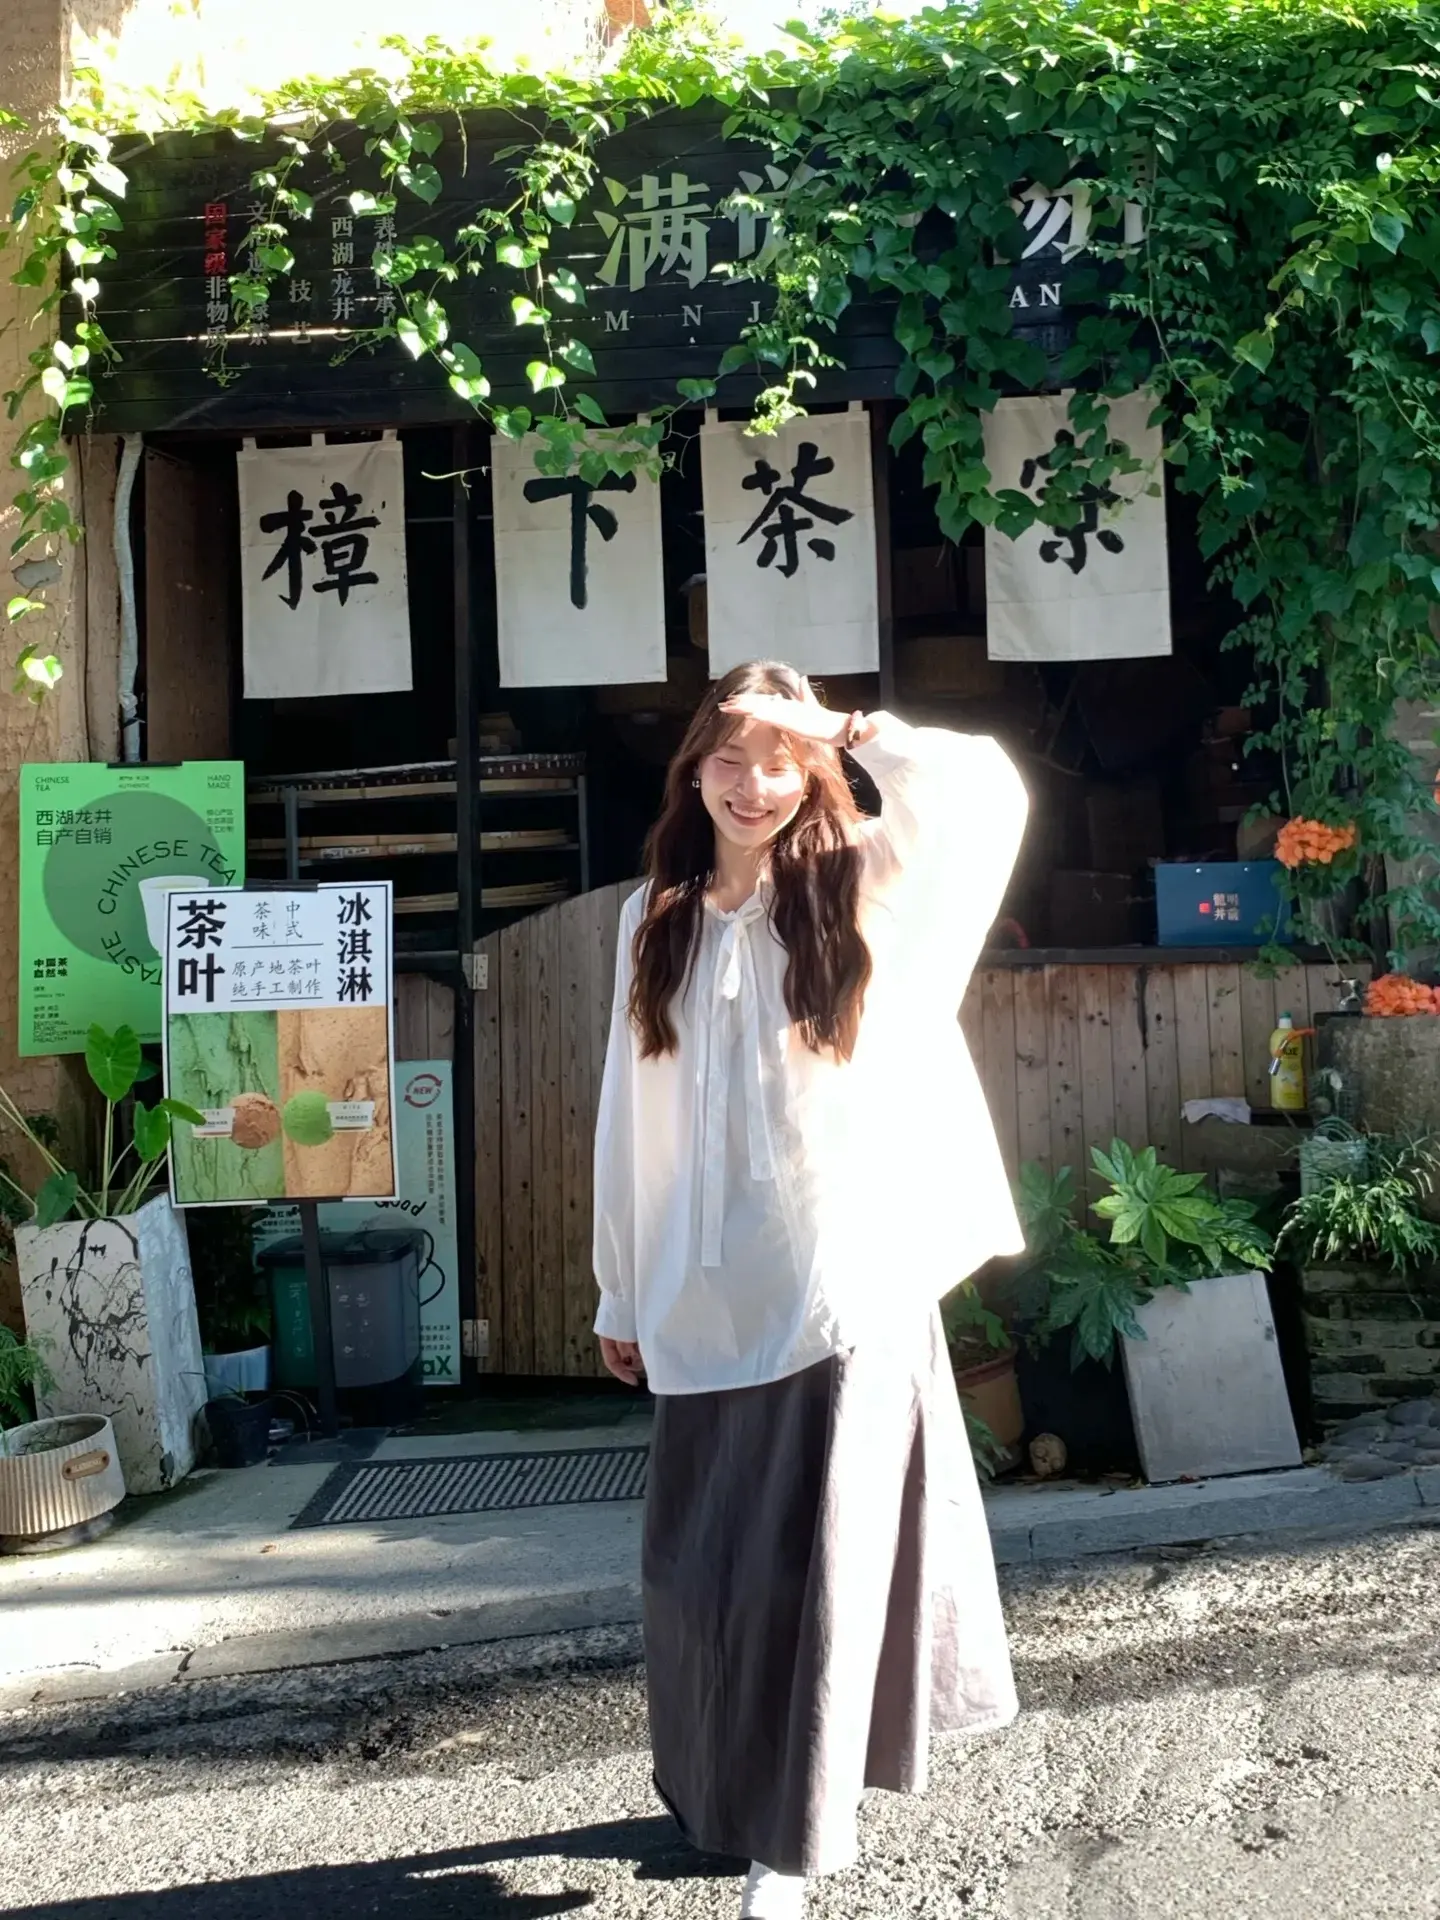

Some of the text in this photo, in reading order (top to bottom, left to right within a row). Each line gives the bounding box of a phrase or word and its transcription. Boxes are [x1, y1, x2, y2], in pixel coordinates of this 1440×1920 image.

[259, 481, 382, 611] 樟
[522, 468, 637, 610] 下
[736, 441, 856, 578] 茶
[35, 776, 70, 784] CHINESE
[207, 774, 231, 782] HAND
[36, 808, 113, 826] 西湖龙井
[36, 827, 113, 846] 自产自销
[98, 839, 237, 914] CHINESE TEA
[252, 901, 272, 940] 茶味
[285, 901, 303, 939] 中式
[176, 899, 227, 1003] 茶叶
[336, 892, 373, 1002] 冰淇淋
[231, 958, 322, 977] 原产地茶叶
[231, 978, 321, 997] 纯手工制作
